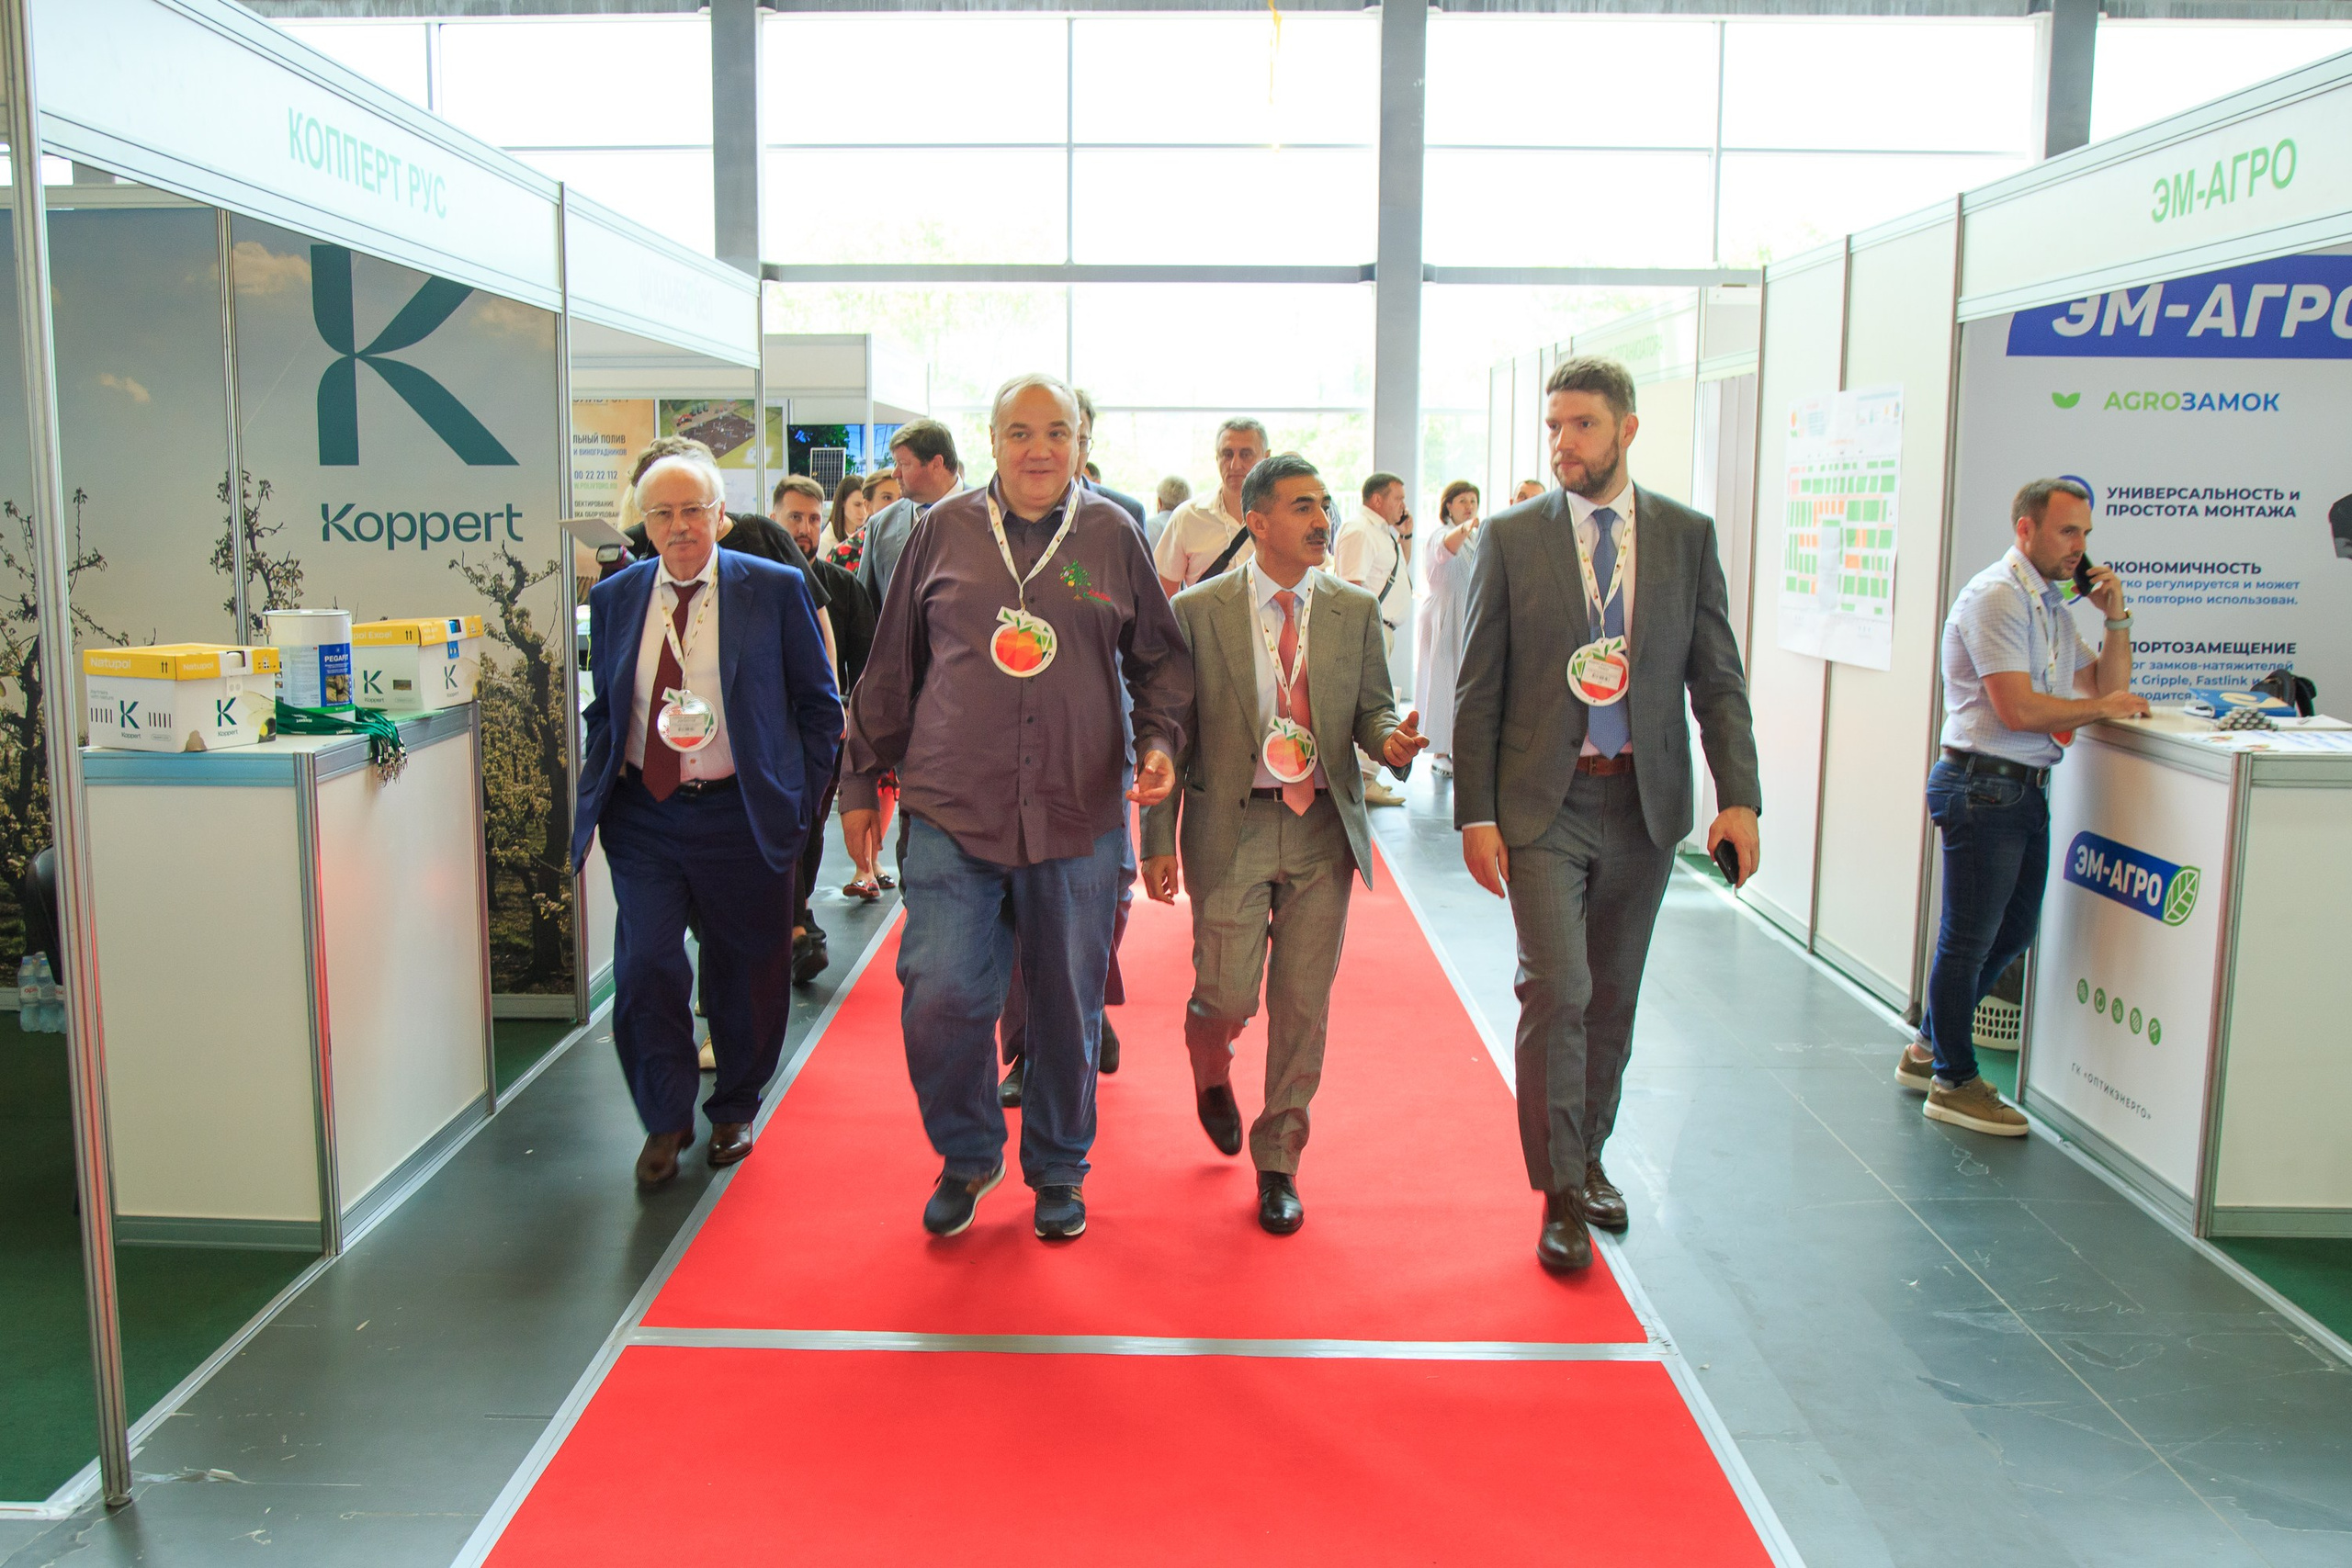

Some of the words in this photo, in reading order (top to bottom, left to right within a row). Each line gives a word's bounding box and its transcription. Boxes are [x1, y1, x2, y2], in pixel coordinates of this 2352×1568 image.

[288, 107, 401, 202] КОППЕРТ
[408, 163, 447, 219] РУС
[2152, 138, 2297, 222] ЭМ-АГРО
[573, 433, 598, 444] ЛЬНЫЙ
[601, 434, 626, 444] ПОЛИВ
[579, 448, 628, 457] ВИНОГРАДНИКОВ
[585, 470, 594, 479] 22
[596, 470, 605, 479] 22
[607, 470, 617, 479] 112
[2107, 487, 2284, 501] УНИВЕРСАЛЬНОСТЬ
[2290, 491, 2301, 501] и
[2106, 504, 2199, 516] ПРОСТОТА
[2204, 505, 2297, 517] МОНТАЖА
[322, 503, 524, 550] Koppert
[2120, 580, 2142, 589] гко
[2146, 580, 2239, 591] регулируется
[2256, 581, 2300, 590] может
[2138, 595, 2202, 605] повторно
[2207, 596, 2298, 605] использован.
[2098, 641, 2296, 655] ПОРТОЗАМЕЩЕНИЕ
[90, 657, 131, 670] Natupol
[183, 660, 214, 671] Natupol
[2149, 660, 2293, 671] замков-натяжителей
[2142, 674, 2192, 687] Gripple,
[2197, 674, 2247, 685] Fastlink
[2075, 844, 2163, 907] ЭМ-АГРО
[2072, 1063, 2081, 1076] ГК
[2083, 1072, 2152, 1120] «ОПТИКЭНЕРГО»
